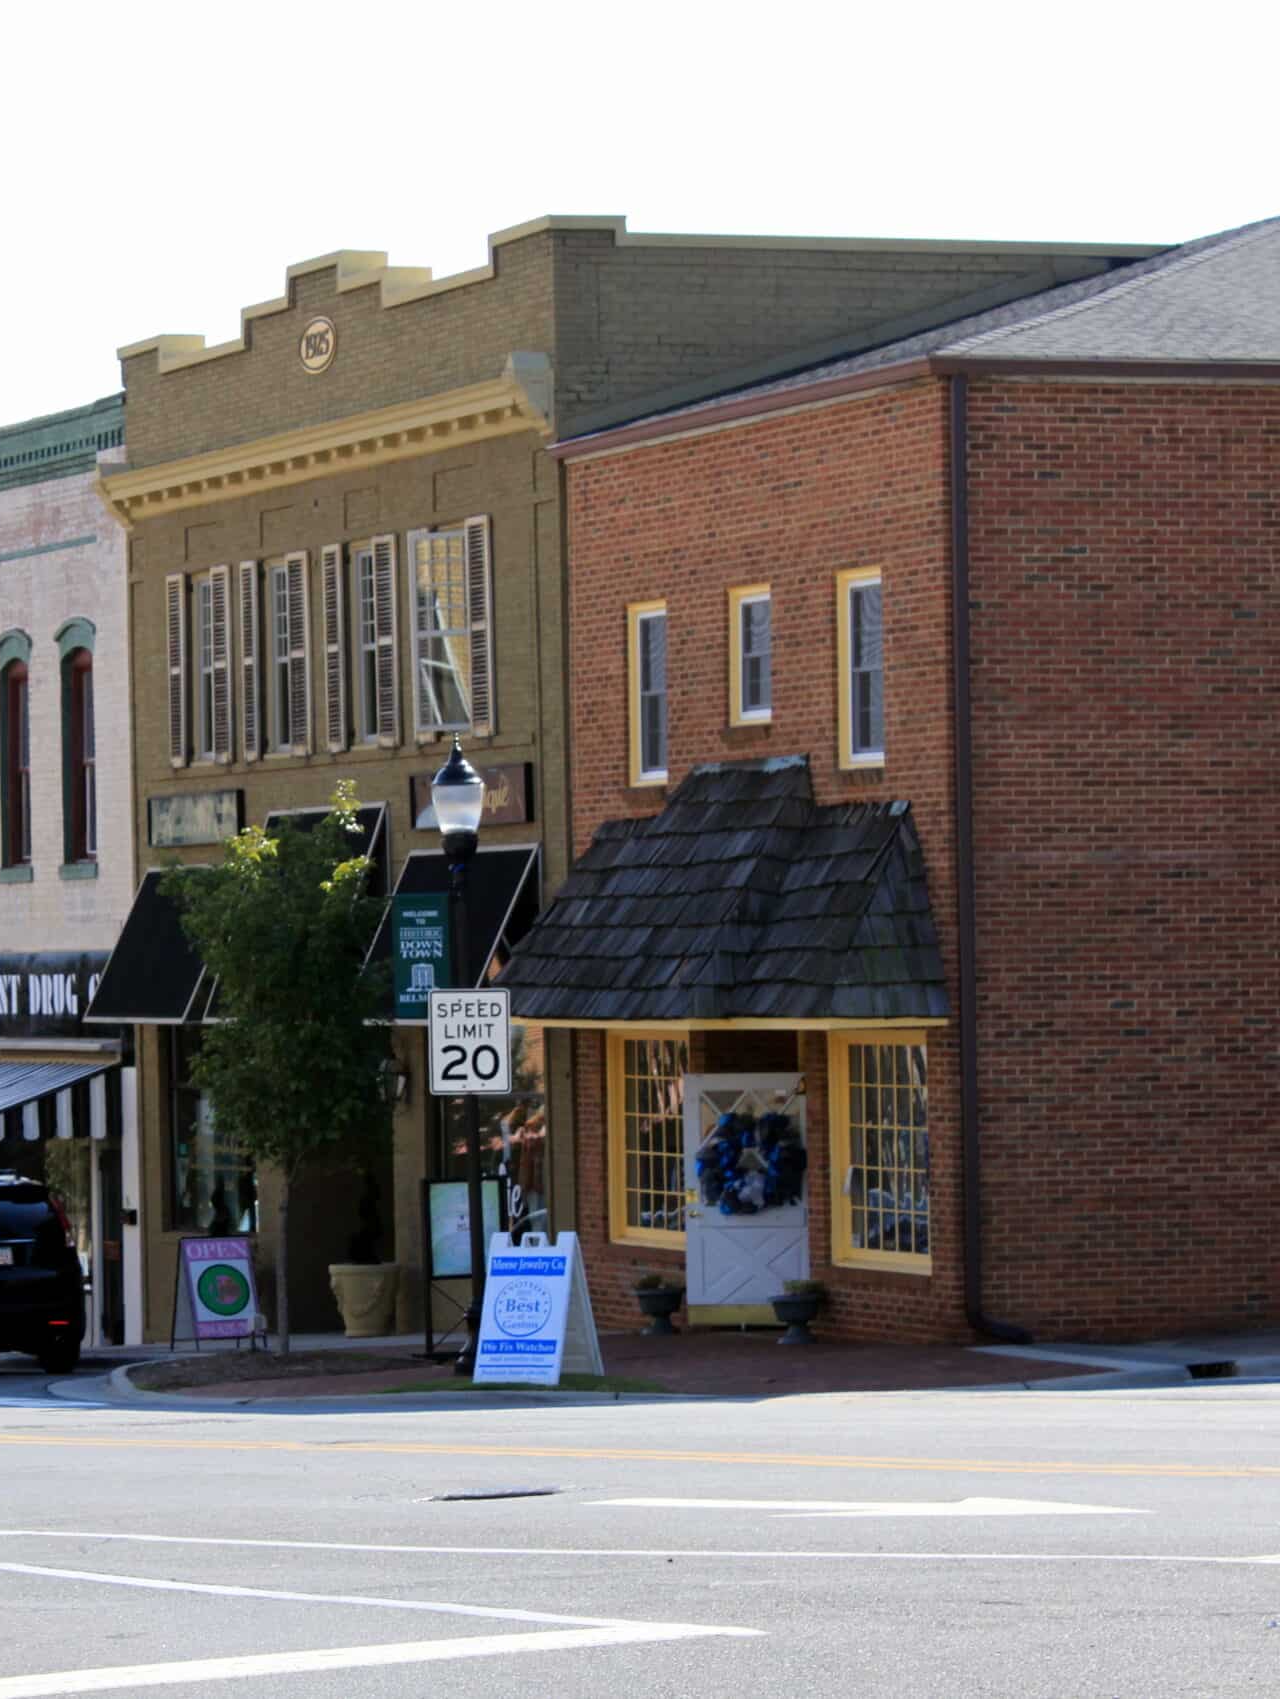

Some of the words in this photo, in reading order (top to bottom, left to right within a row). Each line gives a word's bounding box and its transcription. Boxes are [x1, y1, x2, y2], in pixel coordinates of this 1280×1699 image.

[304, 331, 329, 360] 1925
[400, 940, 443, 950] DOWN
[400, 950, 443, 959] TOWN
[29, 973, 79, 1015] DRUG
[437, 1002, 502, 1018] SPEED
[444, 1023, 495, 1039] LIMIT
[441, 1044, 500, 1081] 20
[185, 1242, 249, 1259] OPEN
[505, 1298, 541, 1313] Best
